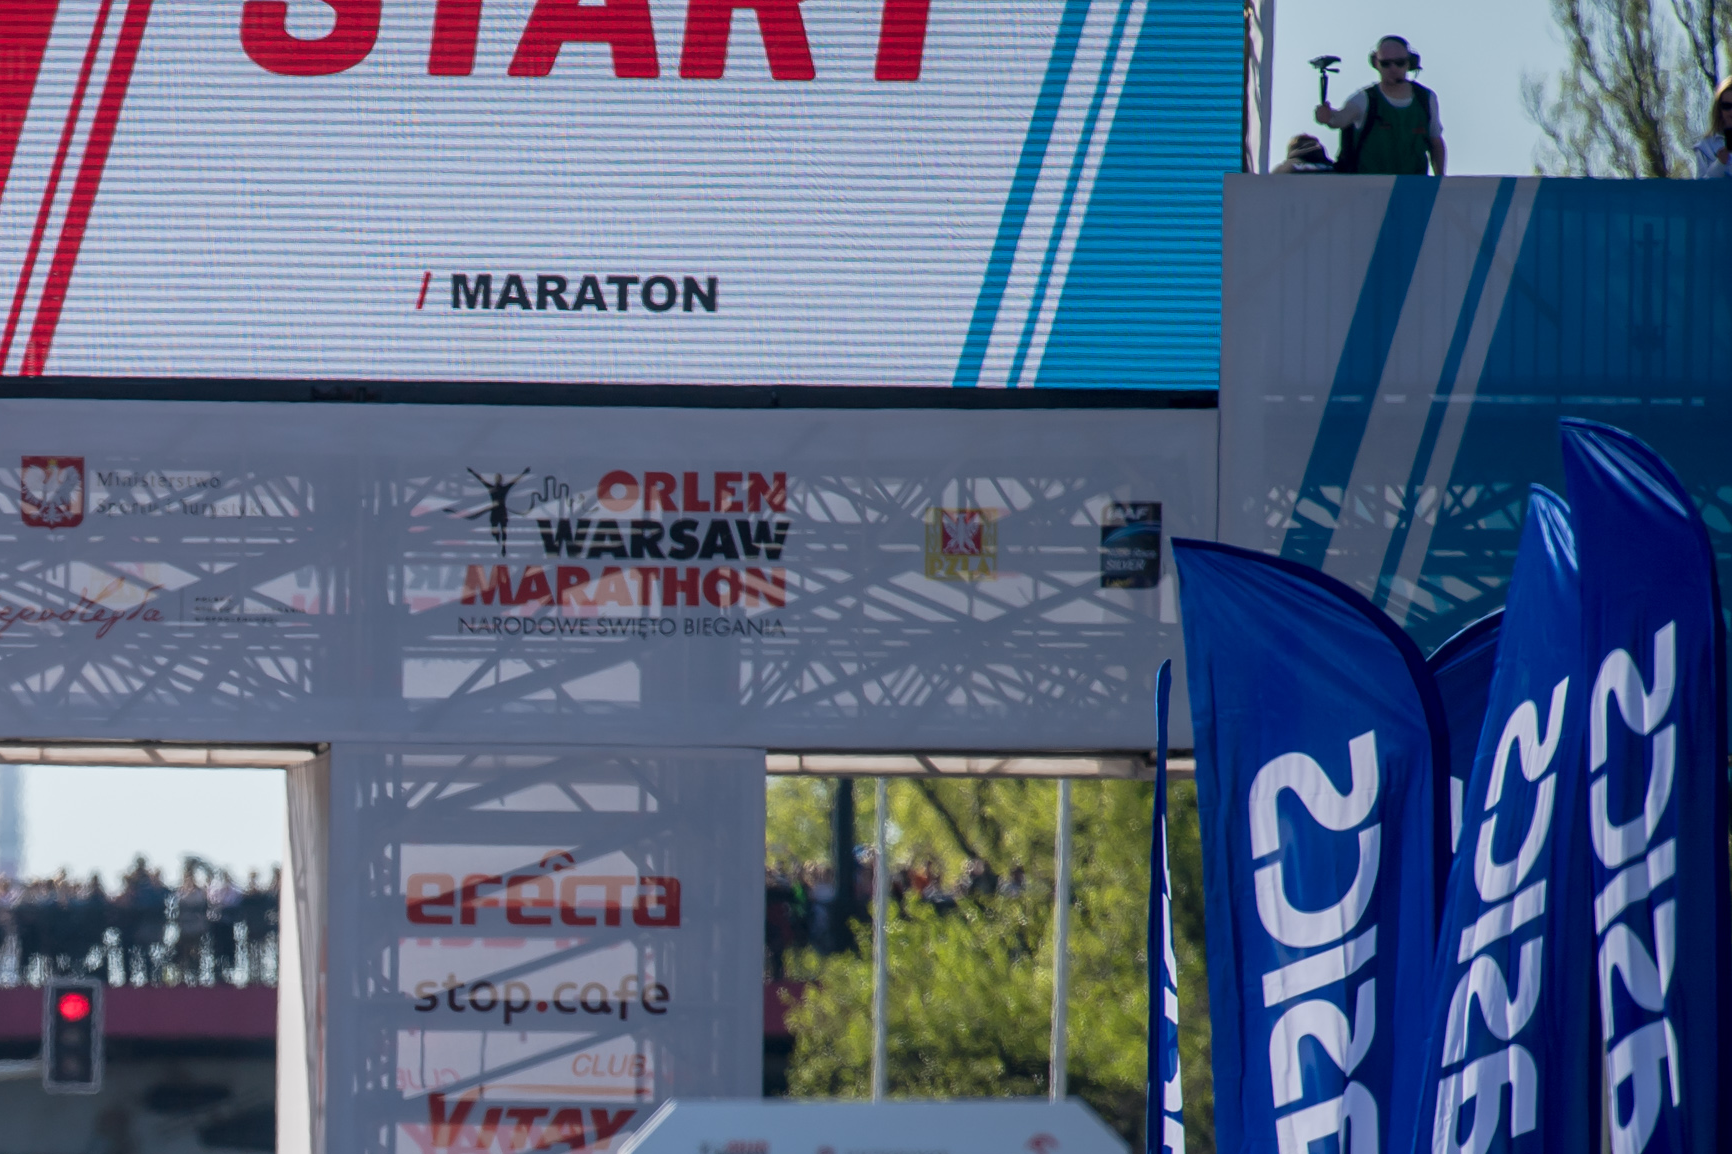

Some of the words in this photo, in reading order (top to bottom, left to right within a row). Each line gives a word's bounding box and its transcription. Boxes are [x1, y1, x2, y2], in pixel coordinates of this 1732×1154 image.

[450, 273, 719, 313] MARATON
[596, 469, 787, 513] ORLEN
[535, 518, 791, 560] WARSAW
[460, 564, 787, 608] MARATHON
[456, 615, 593, 638] NARODOWE
[597, 613, 678, 641] ŚWIĘTO
[683, 616, 788, 639] BIEGANIA
[414, 972, 670, 1026] stop.cafe
[571, 1053, 648, 1078] CLUB
